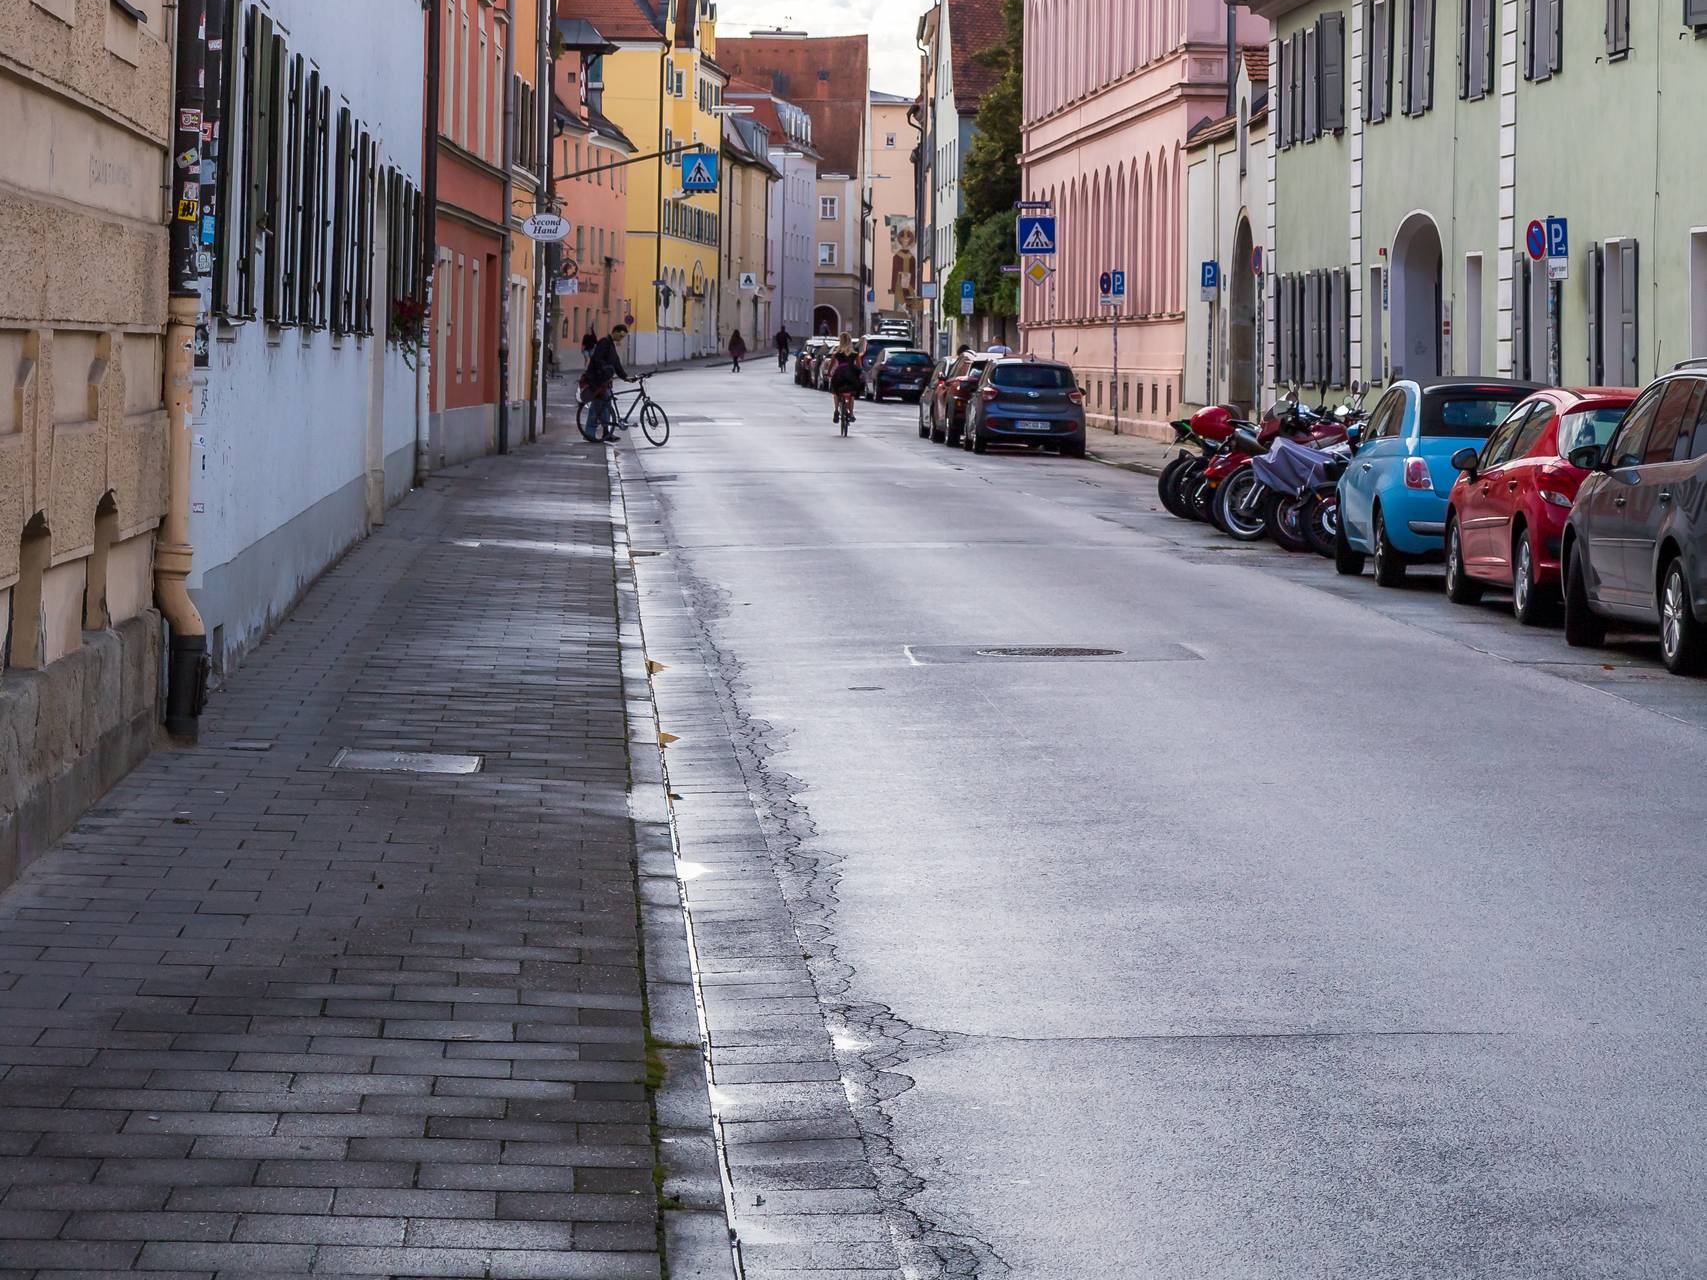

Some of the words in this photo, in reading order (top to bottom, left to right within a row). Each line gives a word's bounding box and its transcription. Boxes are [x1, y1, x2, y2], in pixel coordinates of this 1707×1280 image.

[530, 217, 562, 226] Second
[533, 226, 558, 234] Hand
[1551, 223, 1563, 255] P
[1115, 274, 1122, 292] P
[1204, 265, 1214, 286] P
[963, 283, 971, 297] P
